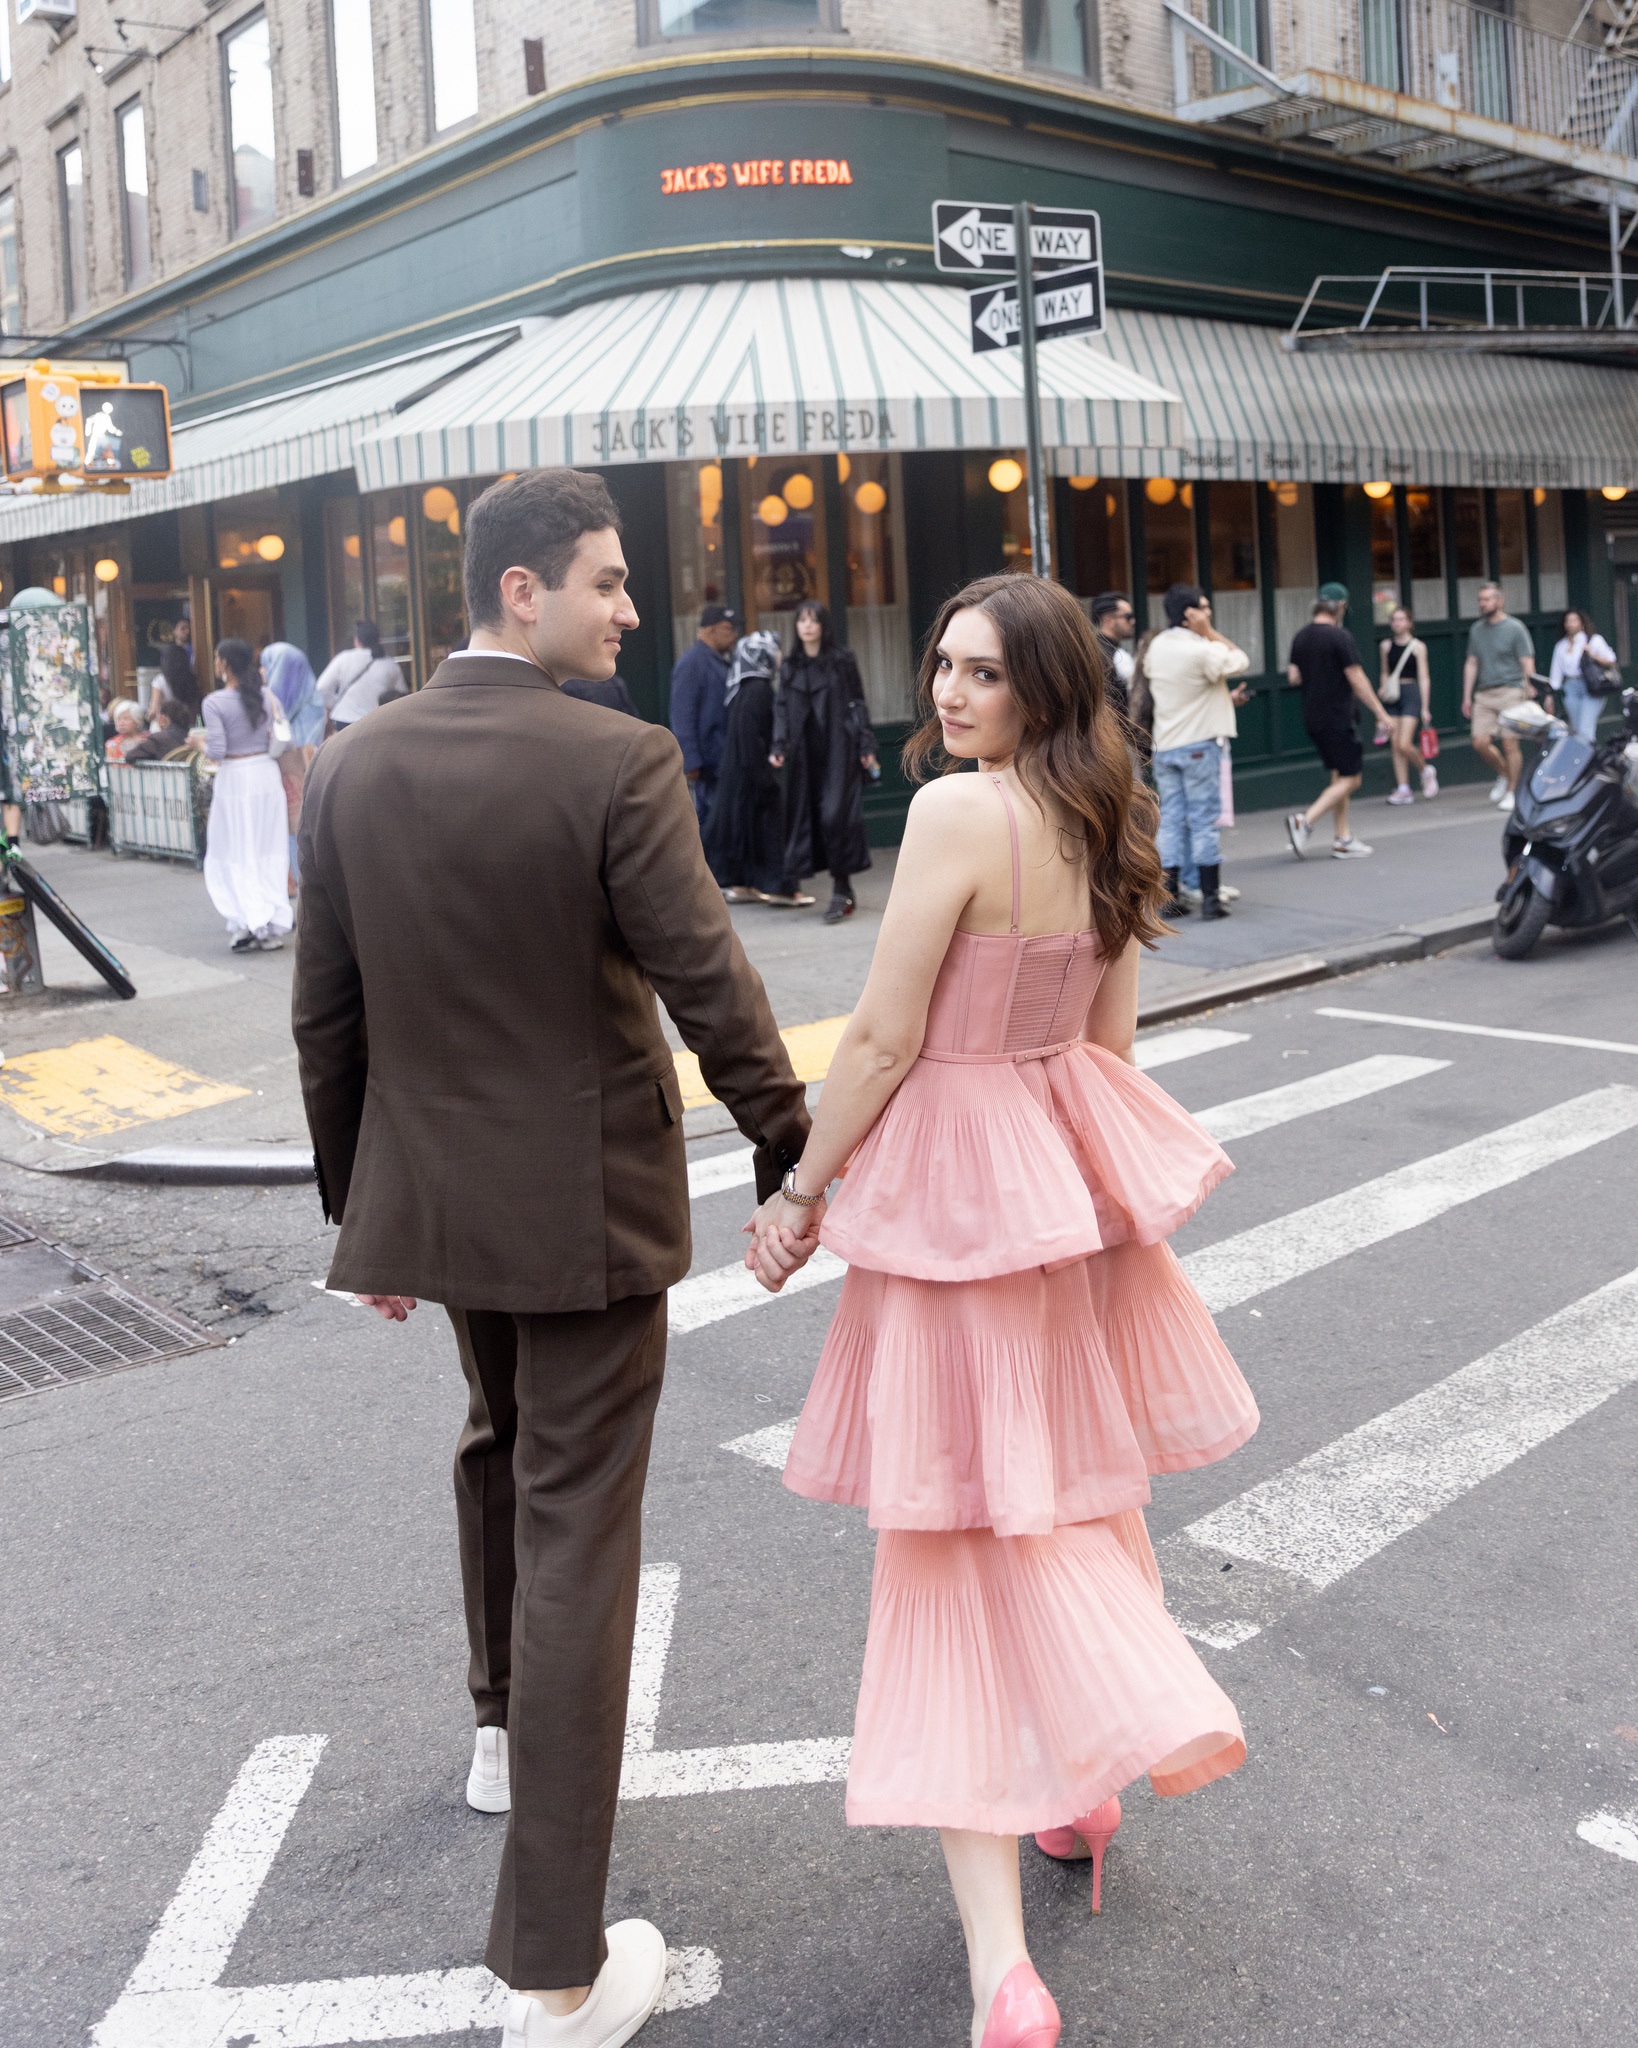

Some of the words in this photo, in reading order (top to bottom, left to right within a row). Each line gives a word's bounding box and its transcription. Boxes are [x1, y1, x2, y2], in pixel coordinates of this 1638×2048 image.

[661, 162, 728, 194] JACK'S
[732, 160, 784, 186] WIFE
[789, 159, 853, 185] FREDA
[960, 226, 1007, 251] ONE
[1034, 230, 1083, 255] WAY
[1042, 290, 1083, 320] WAY
[592, 414, 694, 452] JACK'S
[710, 412, 785, 445] WIFE
[802, 409, 897, 443] FREDA
